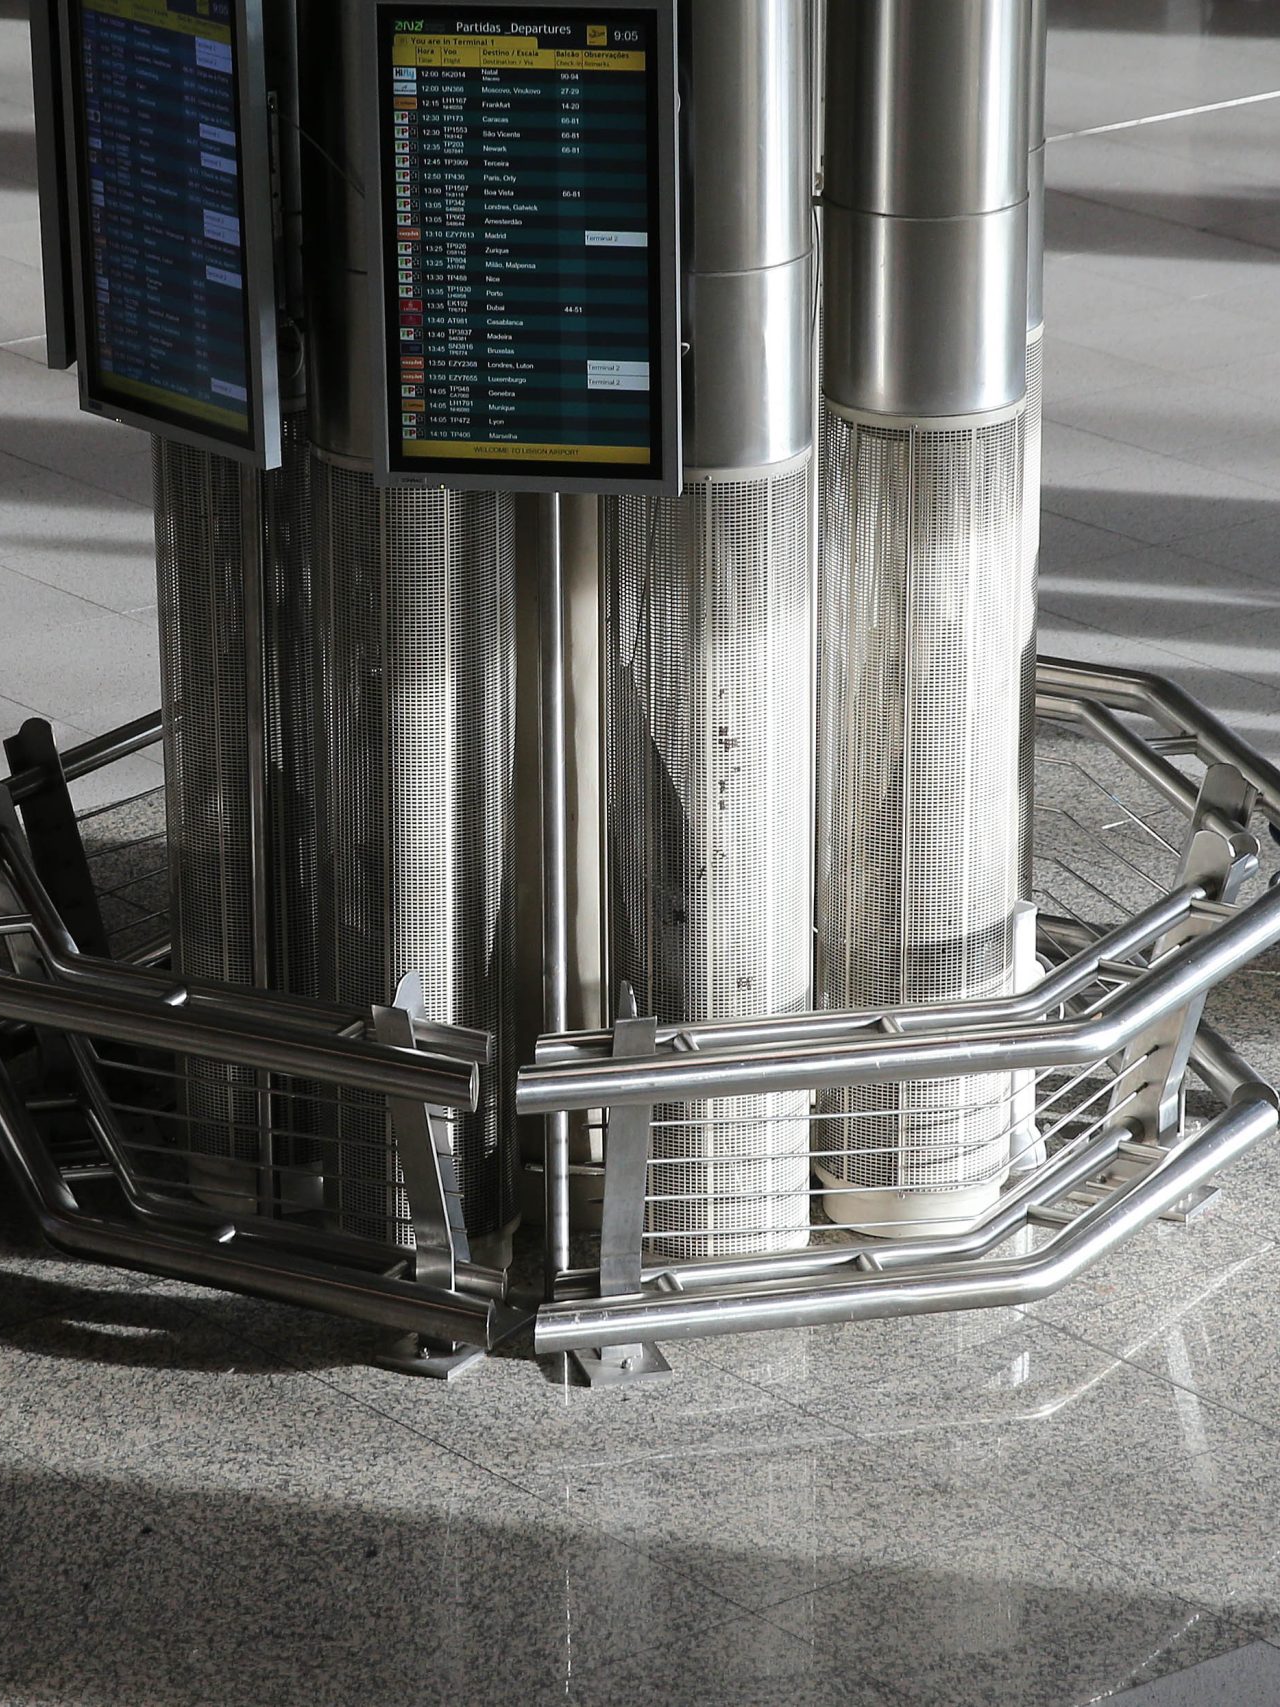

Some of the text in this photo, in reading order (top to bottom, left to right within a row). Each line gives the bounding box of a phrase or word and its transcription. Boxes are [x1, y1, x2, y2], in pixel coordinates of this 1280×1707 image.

[456, 21, 501, 33] Partidas
[614, 30, 638, 42] 9:05
[443, 38, 451, 46] in
[453, 38, 488, 46] Terminal
[556, 50, 580, 58] Balcão
[584, 51, 629, 59] Observações
[481, 86, 512, 94] Moscovo,
[482, 101, 511, 109] Frankfurt
[482, 130, 496, 138] São
[483, 145, 508, 153] Newark
[424, 158, 441, 166] 12:45
[483, 159, 510, 167] Terceira
[483, 174, 502, 182] Paris,
[503, 175, 517, 183] Orly
[484, 204, 512, 212] Londres,
[512, 204, 538, 212] Gatwick
[484, 218, 523, 226] Amesterdão
[484, 232, 507, 240] Madrid
[586, 234, 613, 242] Terminal
[485, 247, 510, 255] Zurique
[505, 261, 536, 270] Malpensa
[487, 347, 515, 355] Bruxelas
[487, 361, 515, 369] Londres,
[487, 376, 527, 384] Luxemburgo
[589, 378, 615, 386] Terminal
[488, 390, 516, 398] Genebra
[488, 404, 516, 413] Munique
[488, 418, 505, 426] Lyon
[489, 432, 518, 440] Marselha
